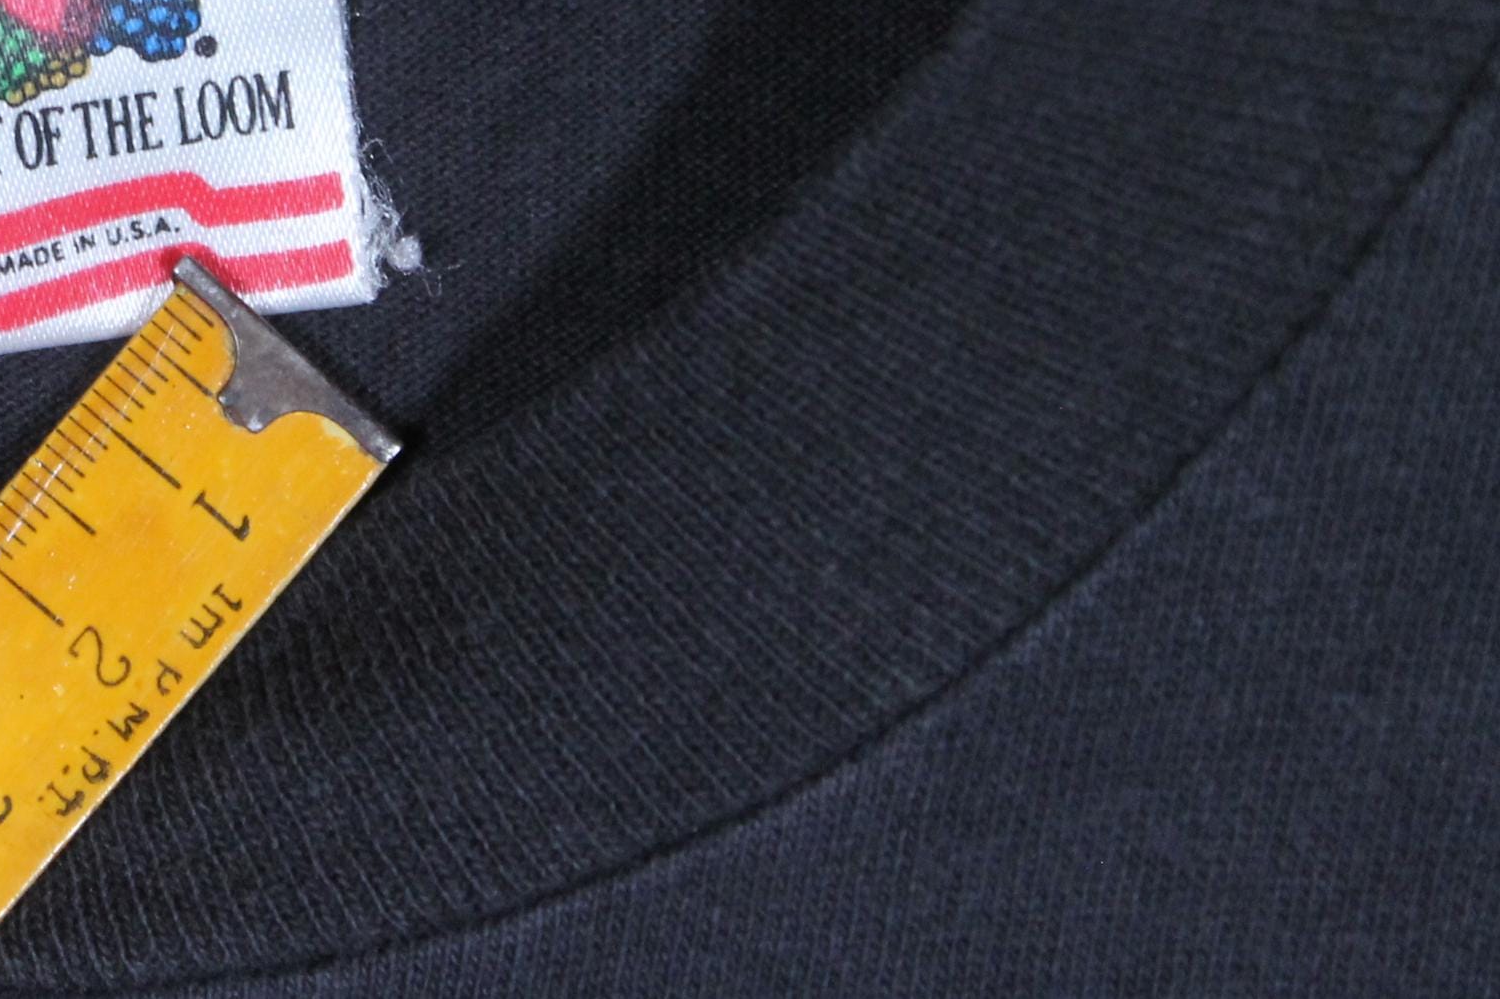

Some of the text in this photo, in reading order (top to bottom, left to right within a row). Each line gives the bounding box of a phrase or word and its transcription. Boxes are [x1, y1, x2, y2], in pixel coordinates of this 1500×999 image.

[14, 105, 65, 171] OF
[71, 90, 164, 160] THE
[173, 69, 296, 147] LOOM
[73, 232, 97, 255] IN
[105, 215, 181, 247] U.S.A.
[191, 490, 252, 542] 1
[68, 625, 132, 688] 2
